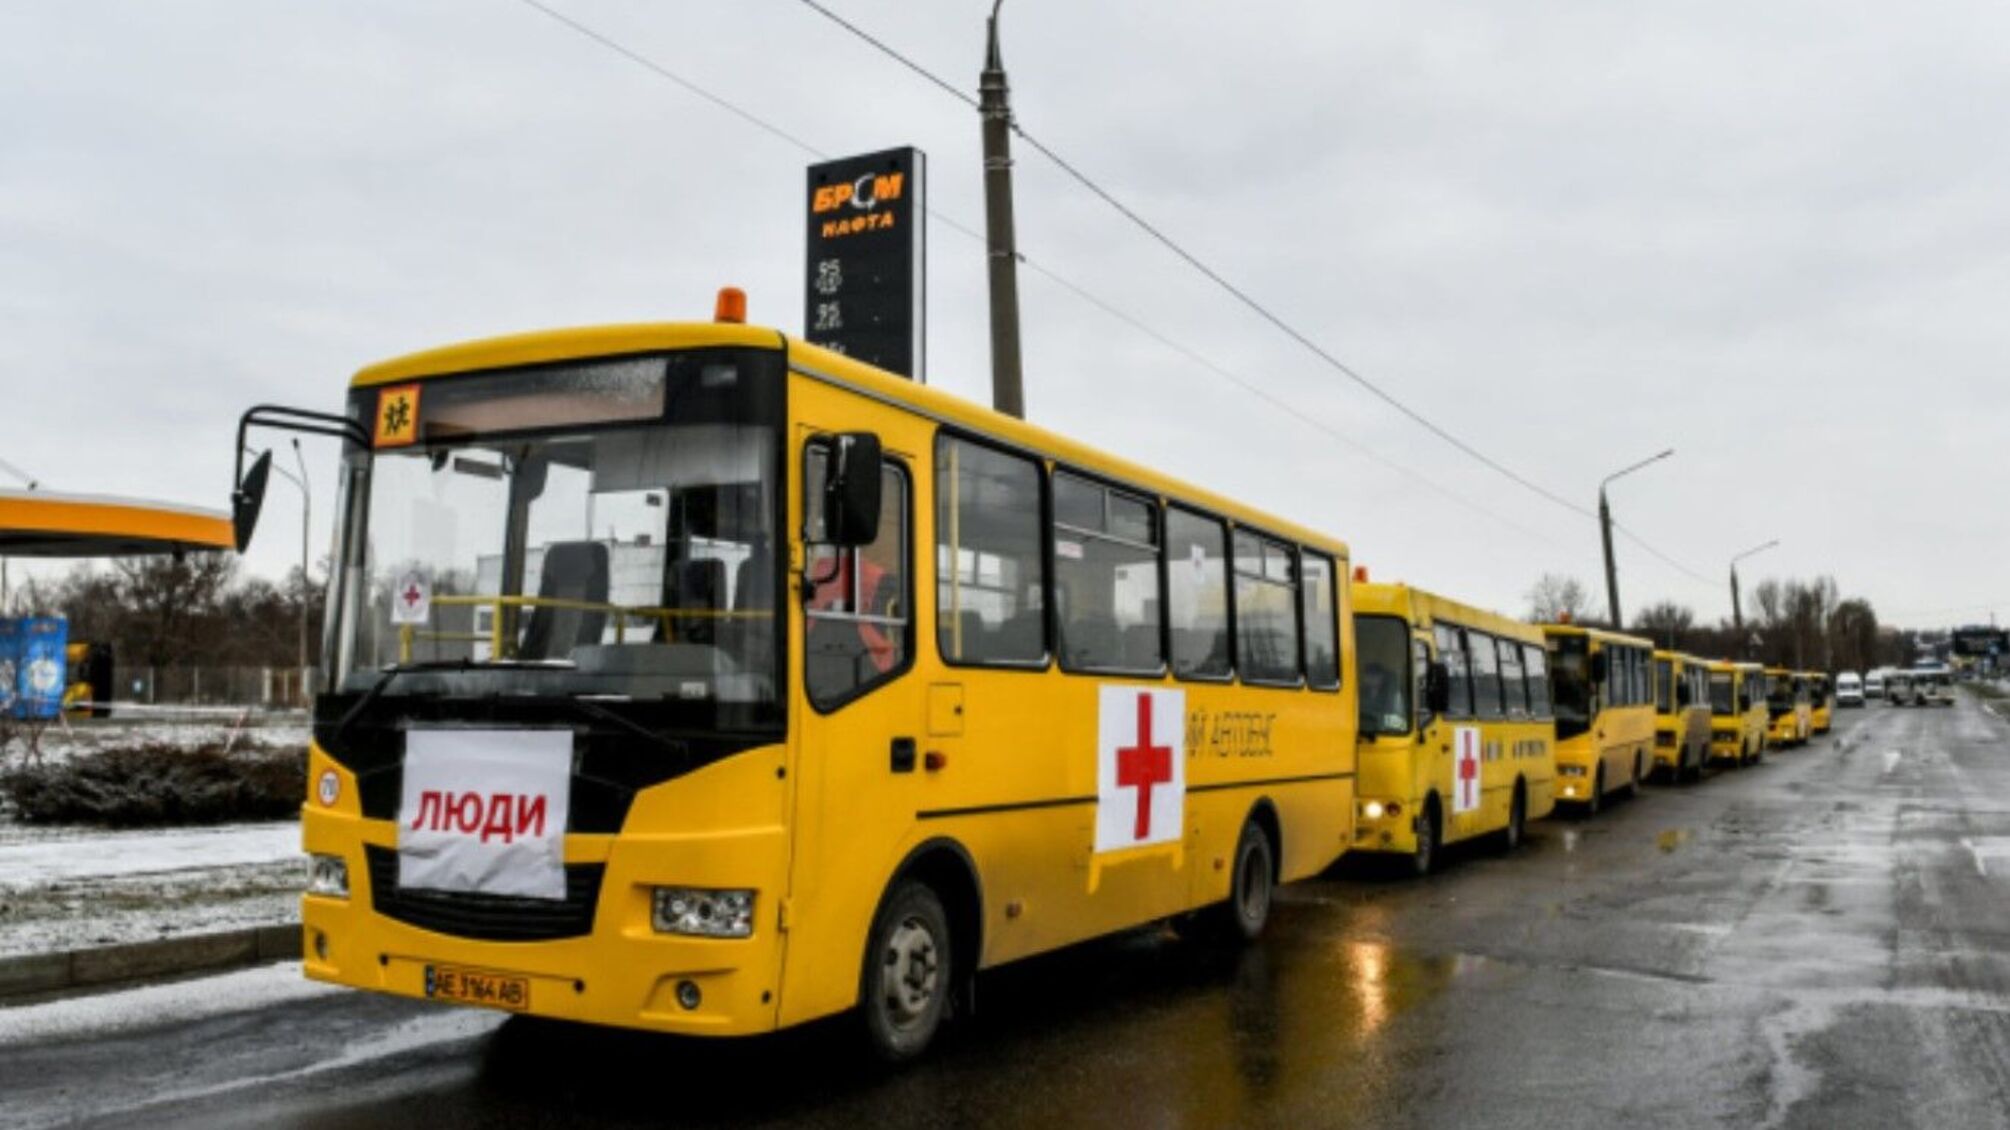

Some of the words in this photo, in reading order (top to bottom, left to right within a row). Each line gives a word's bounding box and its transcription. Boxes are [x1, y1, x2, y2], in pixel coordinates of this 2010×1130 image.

[813, 172, 904, 213] БРСМ
[821, 211, 895, 238] НАФТА
[411, 791, 547, 844] ЛЮДИ
